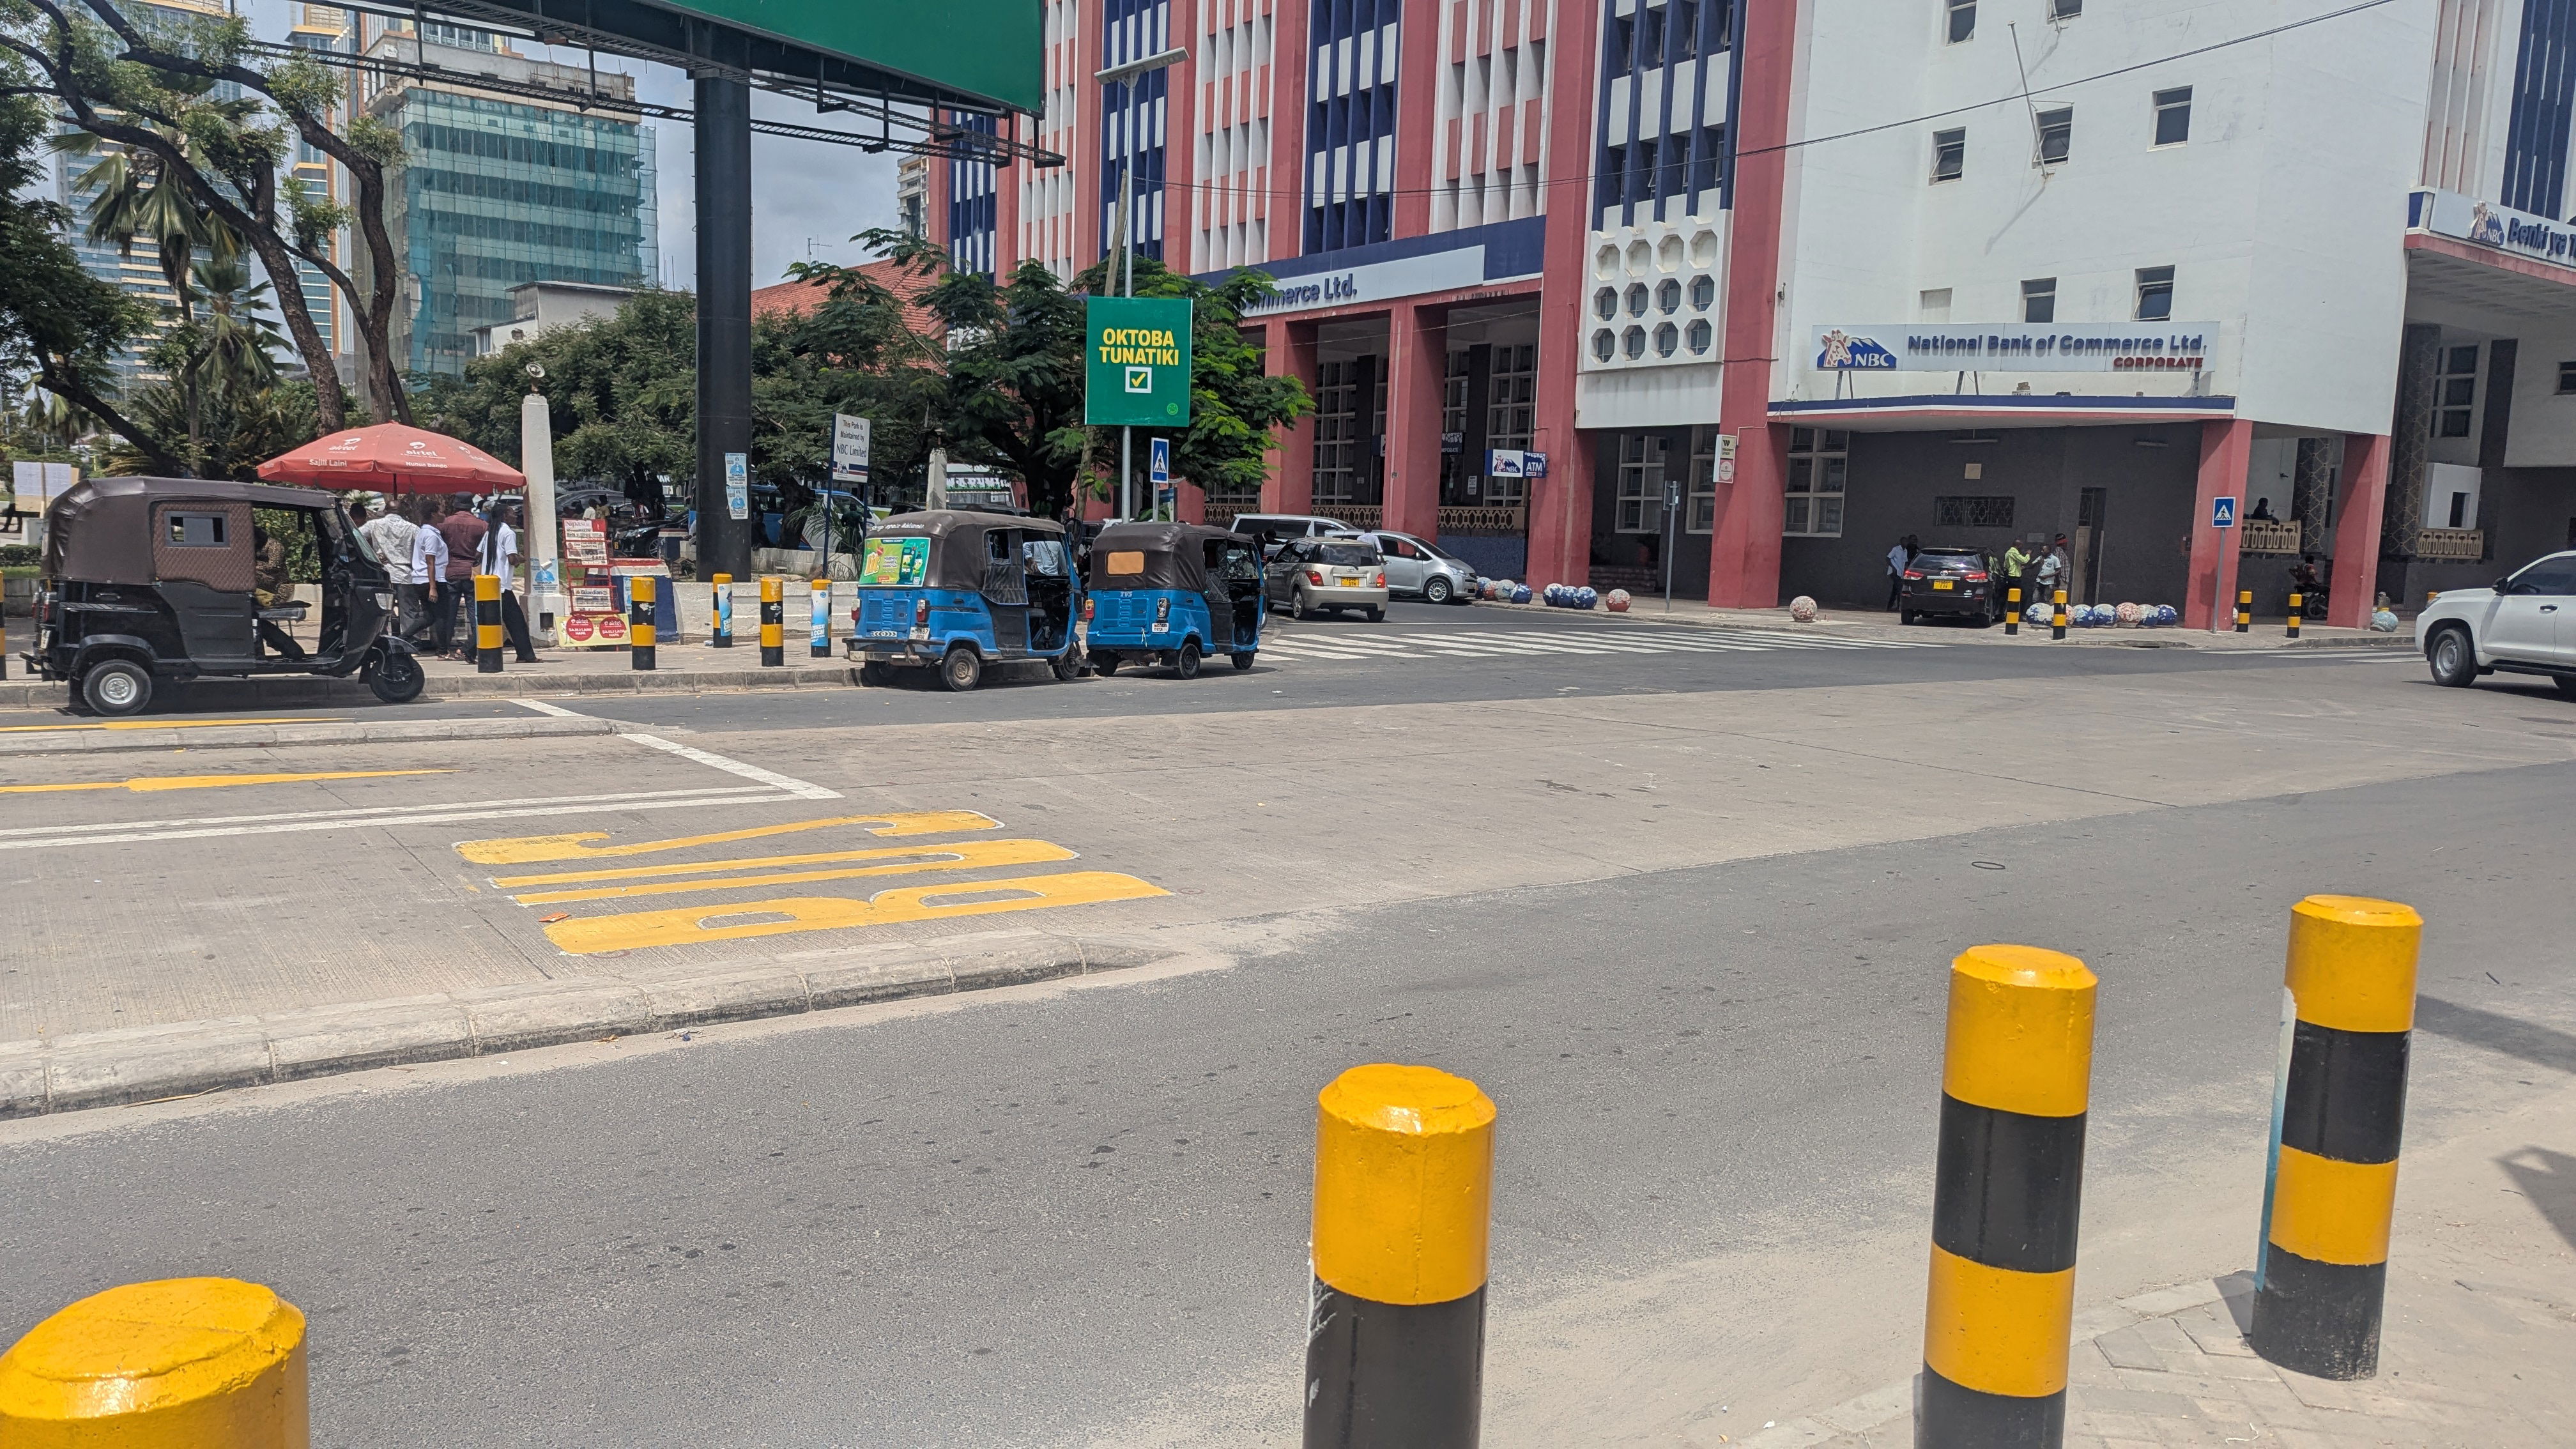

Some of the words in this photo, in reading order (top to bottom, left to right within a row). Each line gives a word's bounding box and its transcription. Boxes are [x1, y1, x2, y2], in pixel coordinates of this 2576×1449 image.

[2487, 228, 2503, 243] NBC
[2507, 217, 2550, 250] Benki
[2547, 231, 2568, 256] ya
[1324, 273, 1358, 300] Ltd.
[1103, 328, 1175, 347] OKTOBA
[1908, 335, 1983, 350] National
[1987, 334, 2032, 350] Bank
[2035, 334, 2057, 349] of
[2060, 335, 2164, 350] Commerce
[2170, 334, 2207, 350] Ltd.
[1099, 346, 1179, 366] TUNATIKI
[1855, 353, 1890, 367] NBC
[2113, 356, 2204, 368] CORPORATE
[843, 419, 851, 427] This
[851, 421, 859, 429] Park
[840, 430, 860, 440] Maintained
[860, 433, 865, 442] by
[836, 443, 848, 456] NBC
[849, 445, 867, 458] Limited
[1526, 461, 1543, 472] ATM
[452, 809, 1173, 956] BUS
